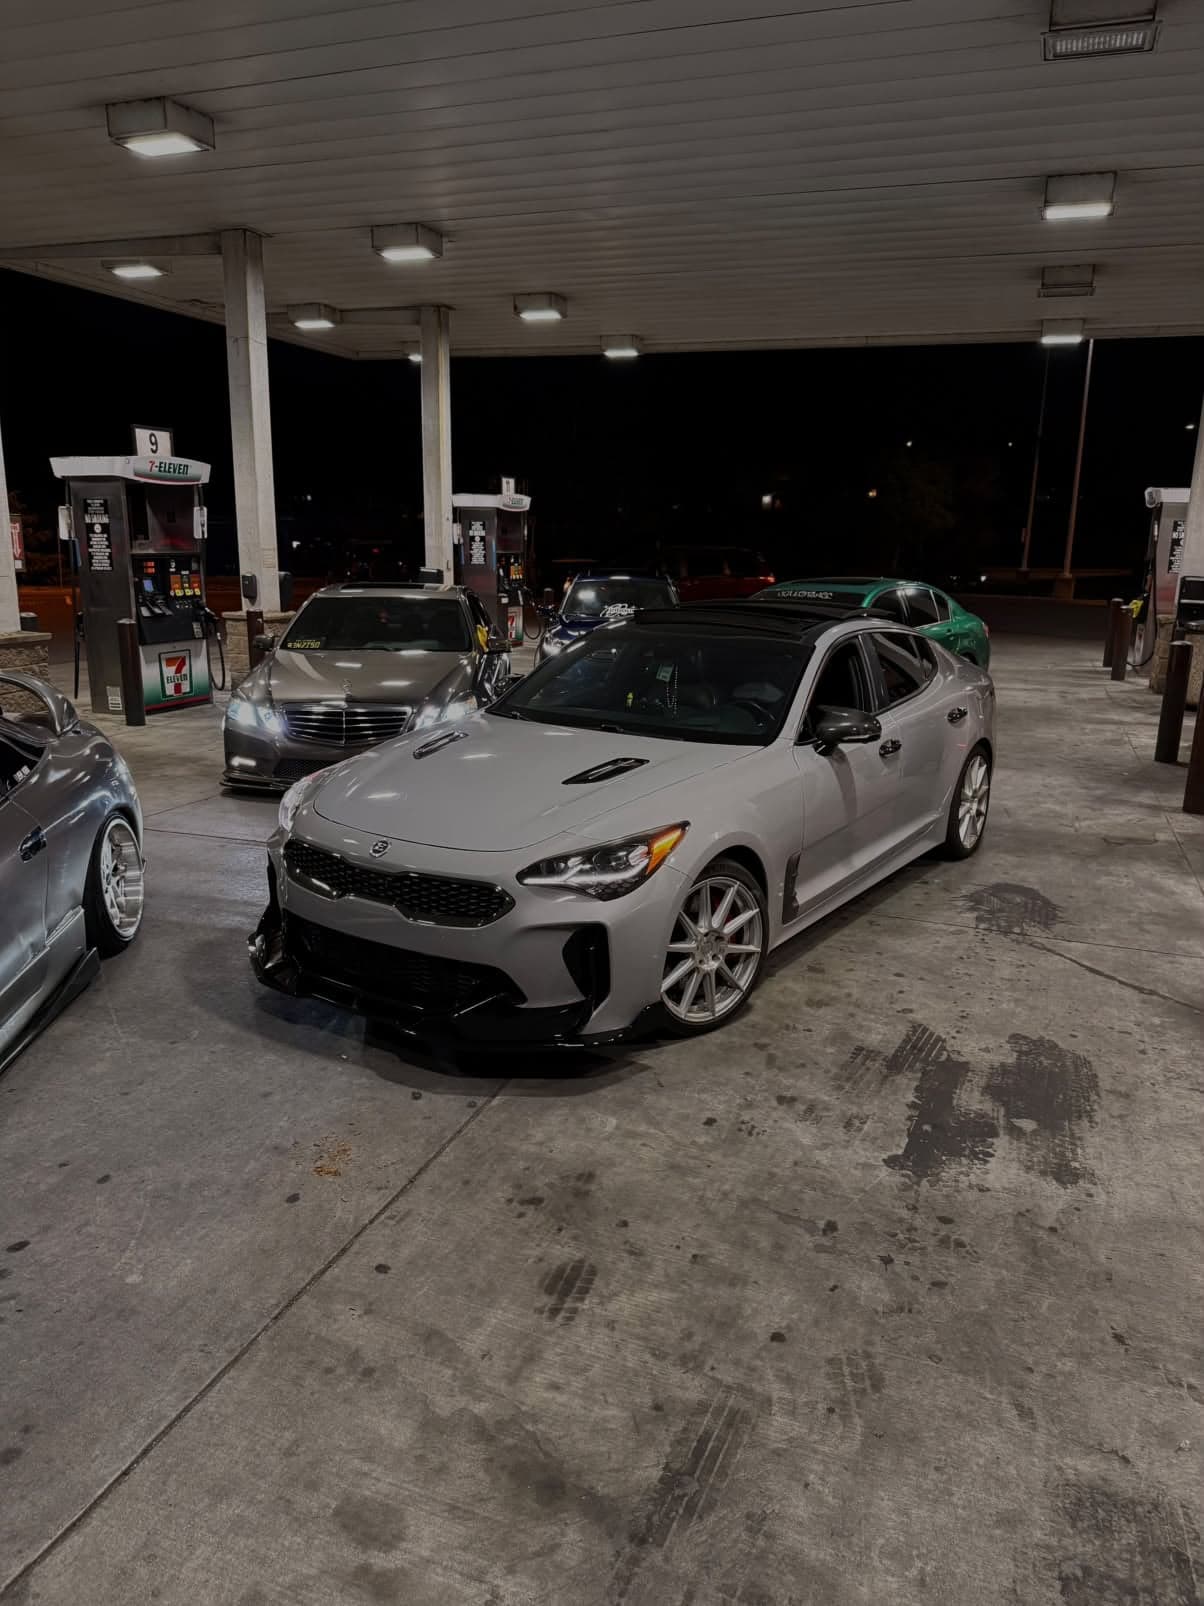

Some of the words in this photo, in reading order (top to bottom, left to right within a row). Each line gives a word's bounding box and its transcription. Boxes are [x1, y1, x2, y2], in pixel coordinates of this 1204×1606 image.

[149, 432, 158, 454] 9
[148, 460, 189, 475] 7-ELEVEN
[165, 656, 187, 694] 7
[166, 674, 188, 684] ELEVEN
